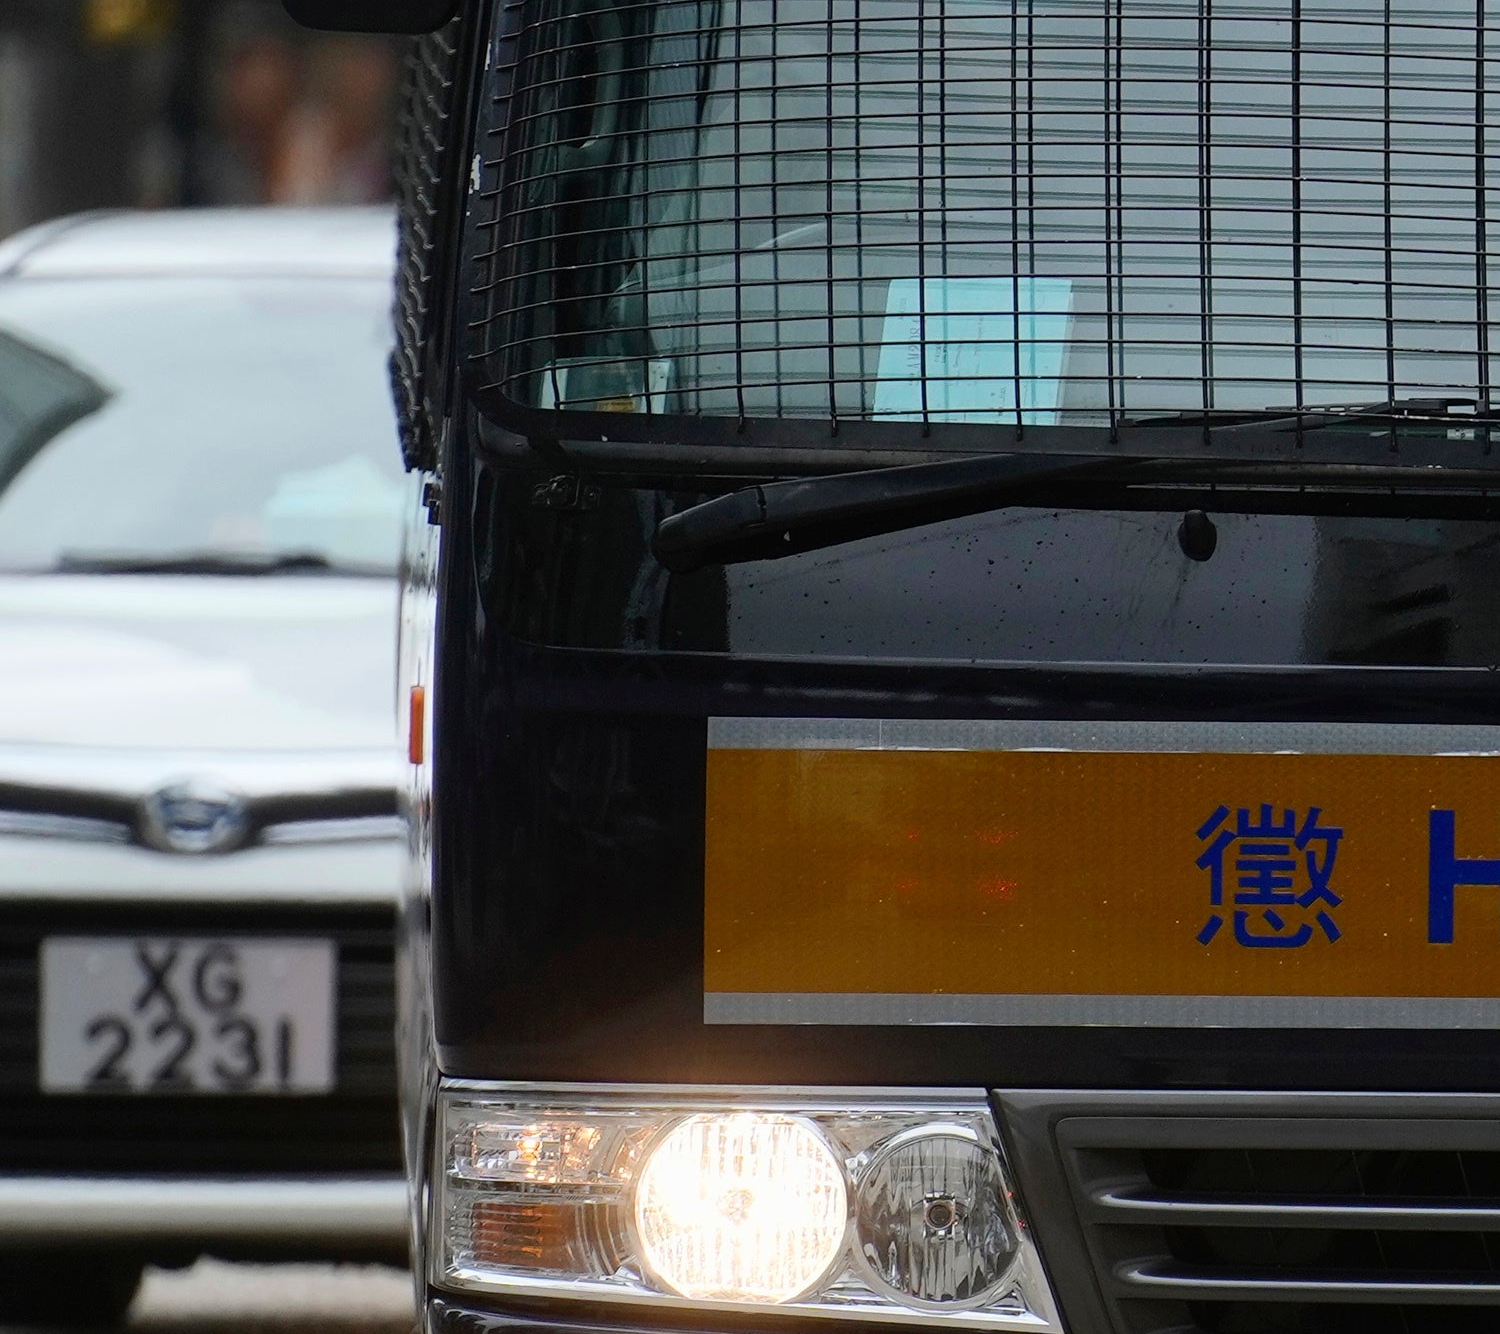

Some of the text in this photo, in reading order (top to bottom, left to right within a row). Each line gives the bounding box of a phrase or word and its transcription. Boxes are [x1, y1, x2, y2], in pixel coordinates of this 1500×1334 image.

[1195, 802, 1344, 948] 懲
[134, 938, 243, 1013] XG
[84, 1014, 293, 1092] 2231
